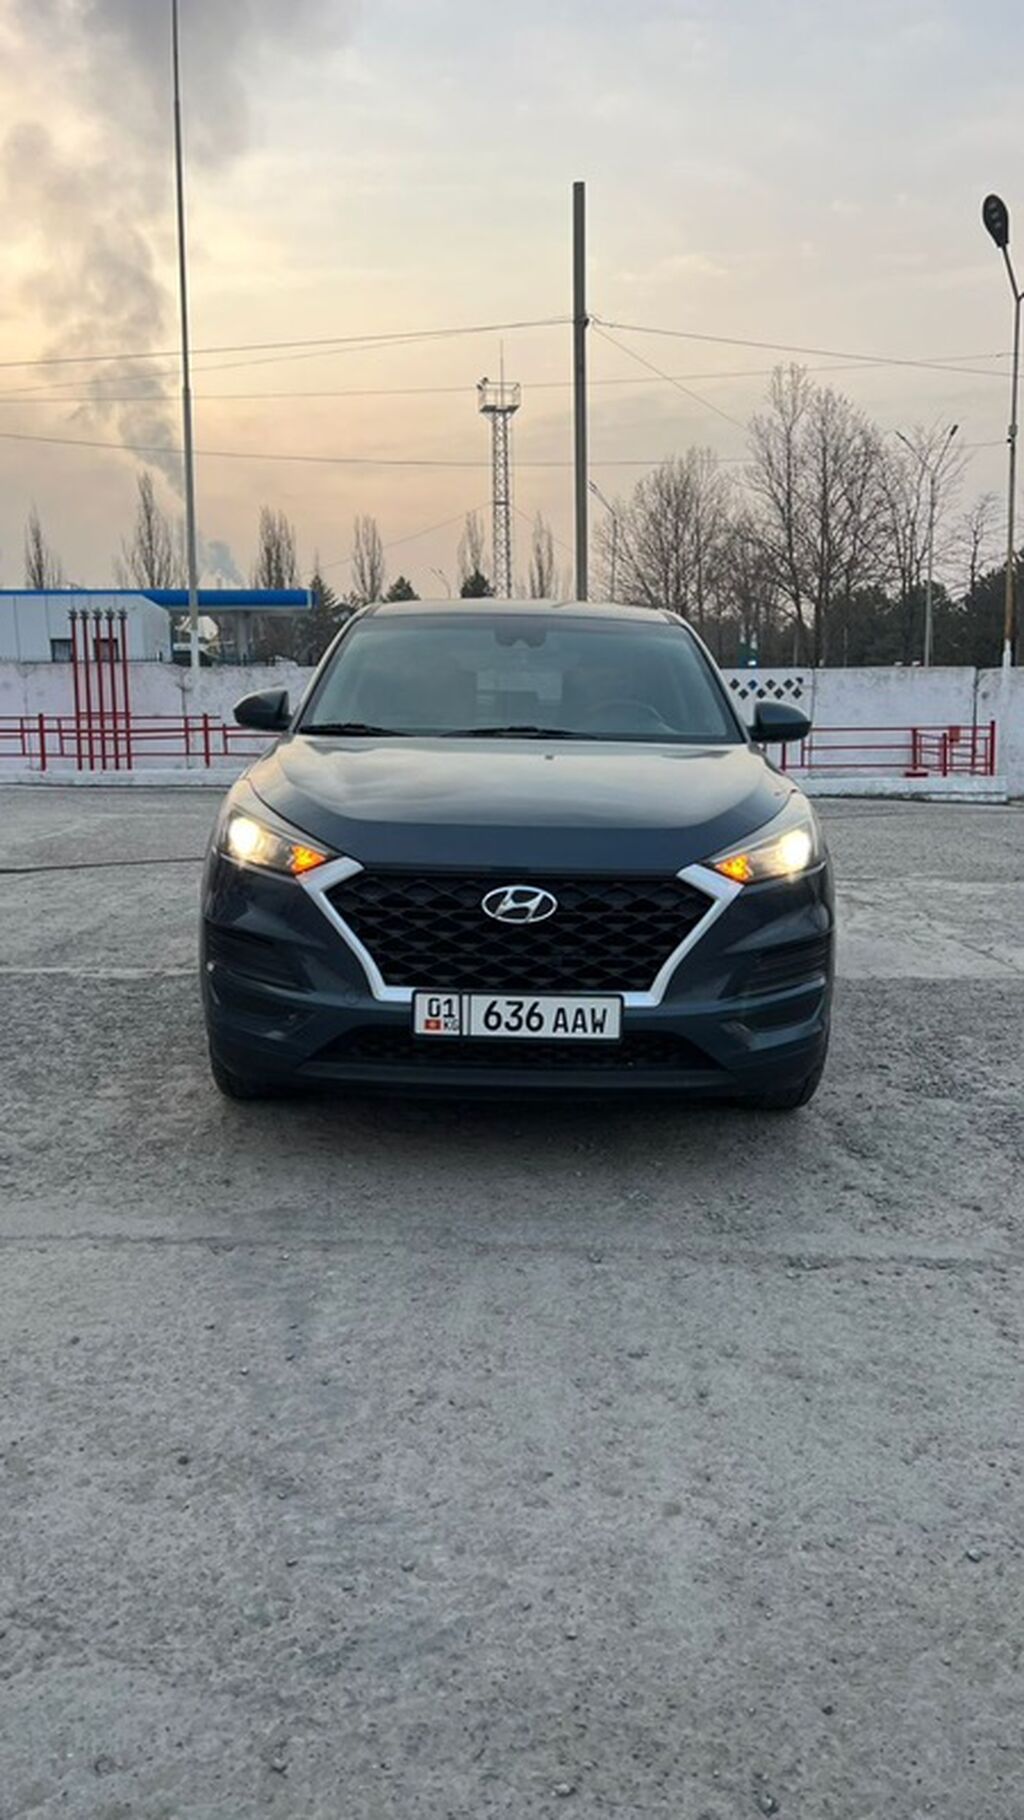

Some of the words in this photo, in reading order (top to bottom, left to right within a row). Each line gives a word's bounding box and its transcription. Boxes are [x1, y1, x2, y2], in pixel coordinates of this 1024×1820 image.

[428, 997, 455, 1018] 01
[483, 1000, 544, 1032] 636
[552, 1007, 607, 1033] AAW
